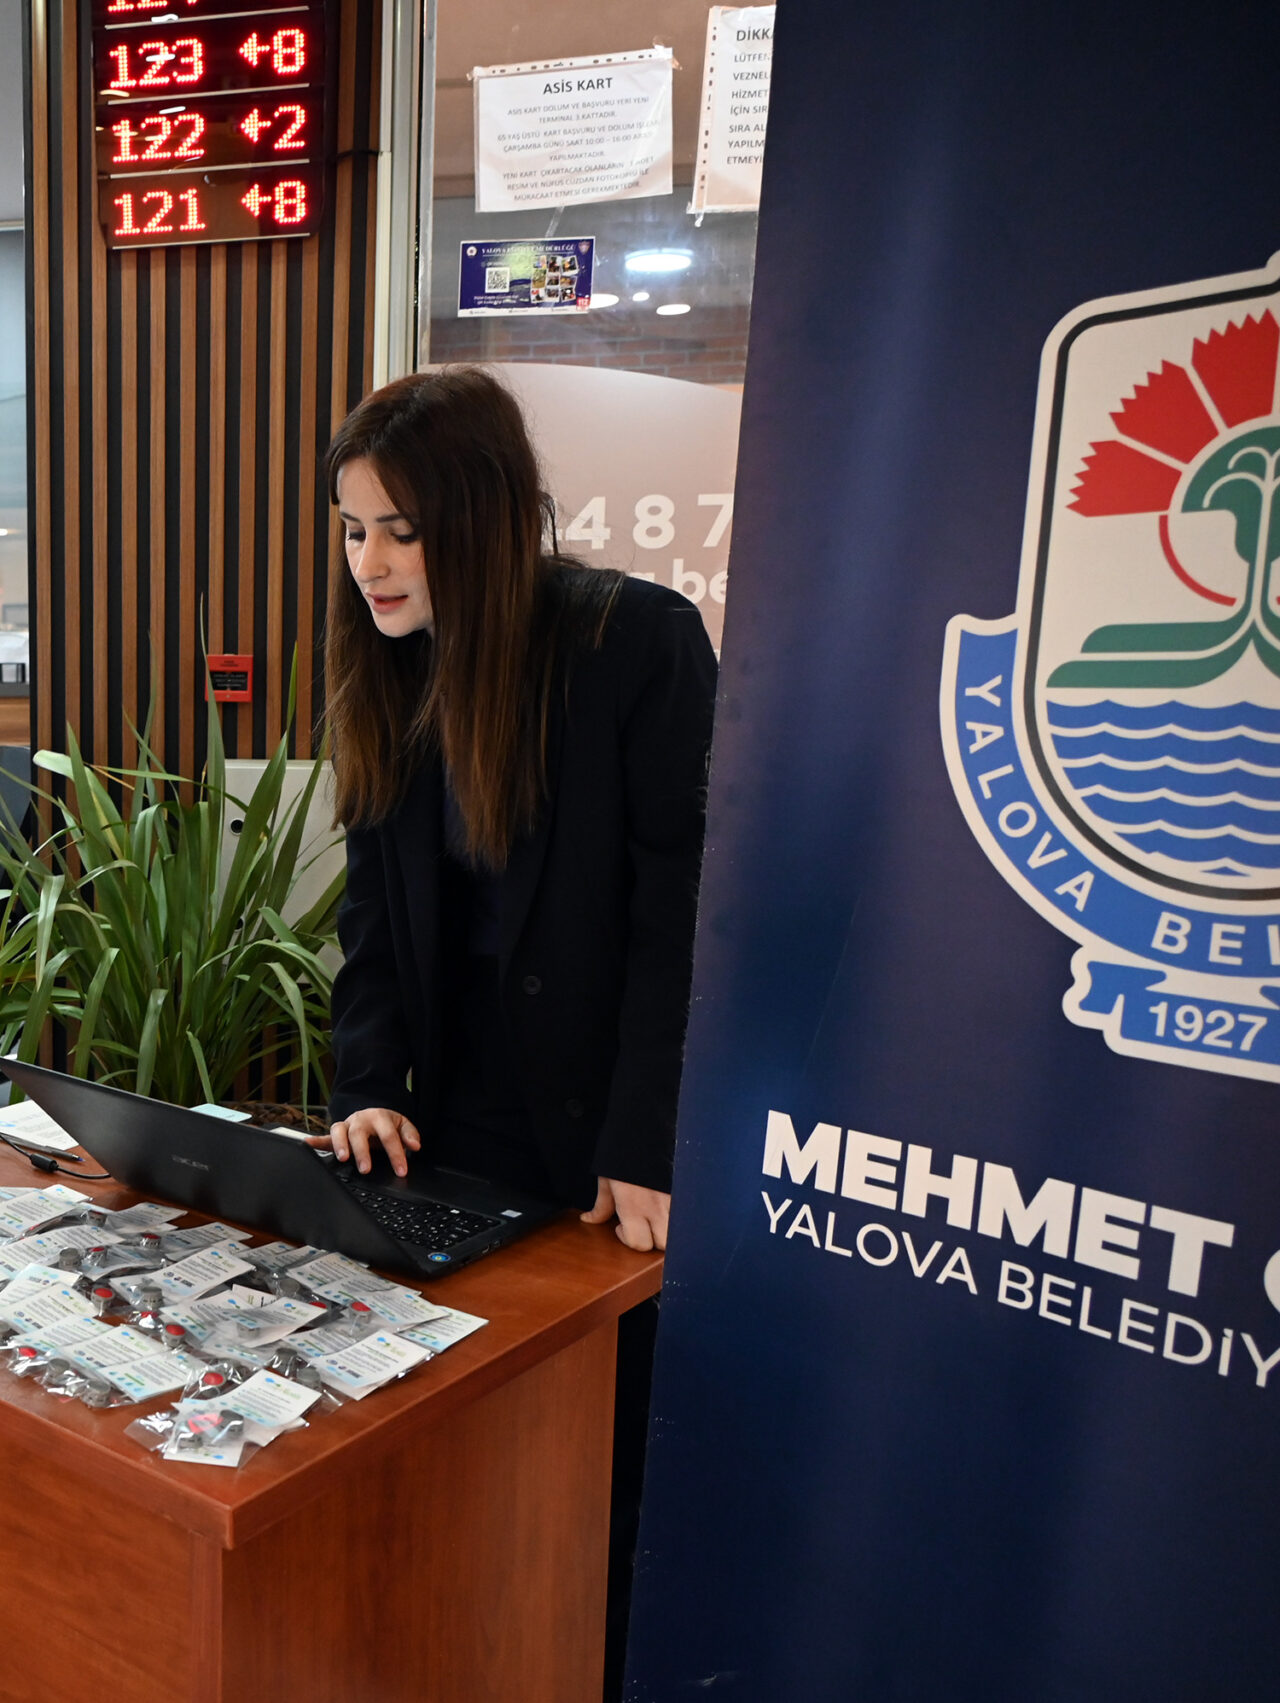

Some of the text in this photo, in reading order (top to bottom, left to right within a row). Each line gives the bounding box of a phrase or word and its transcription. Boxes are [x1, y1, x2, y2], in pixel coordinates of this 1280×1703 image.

[110, 28, 305, 88] 123 8
[736, 26, 773, 42] DİKK
[542, 77, 613, 94] ASİS KART
[112, 104, 306, 162] 122 2
[729, 124, 751, 133] SIRA
[114, 180, 306, 236] 121 8
[964, 674, 1095, 912] YALOVA
[1148, 1001, 1267, 1052] 1927
[762, 1109, 1235, 1298] MEHMET
[761, 1191, 978, 1295] YALOVA
[998, 1260, 1280, 1388] BELEDİY
